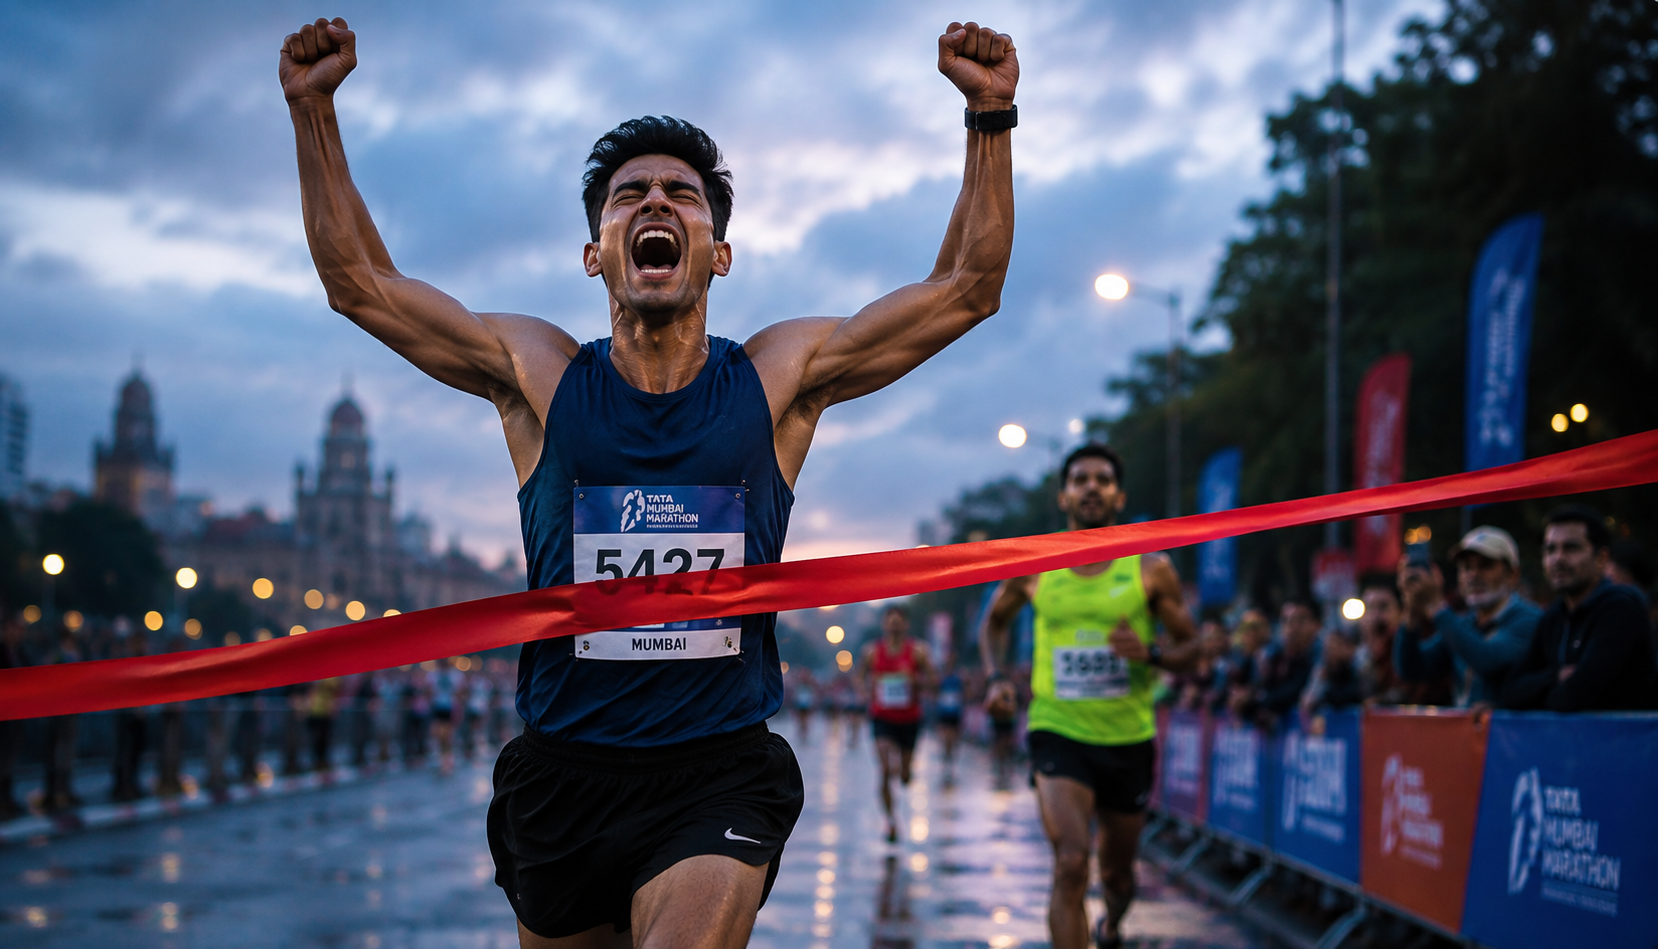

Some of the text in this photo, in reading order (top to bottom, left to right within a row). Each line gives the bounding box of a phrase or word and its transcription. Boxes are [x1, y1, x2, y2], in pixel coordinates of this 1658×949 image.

[646, 494, 674, 503] TATA
[646, 513, 699, 523] MARATHON
[595, 548, 725, 595] 5427
[631, 637, 687, 651] MUMBAI
